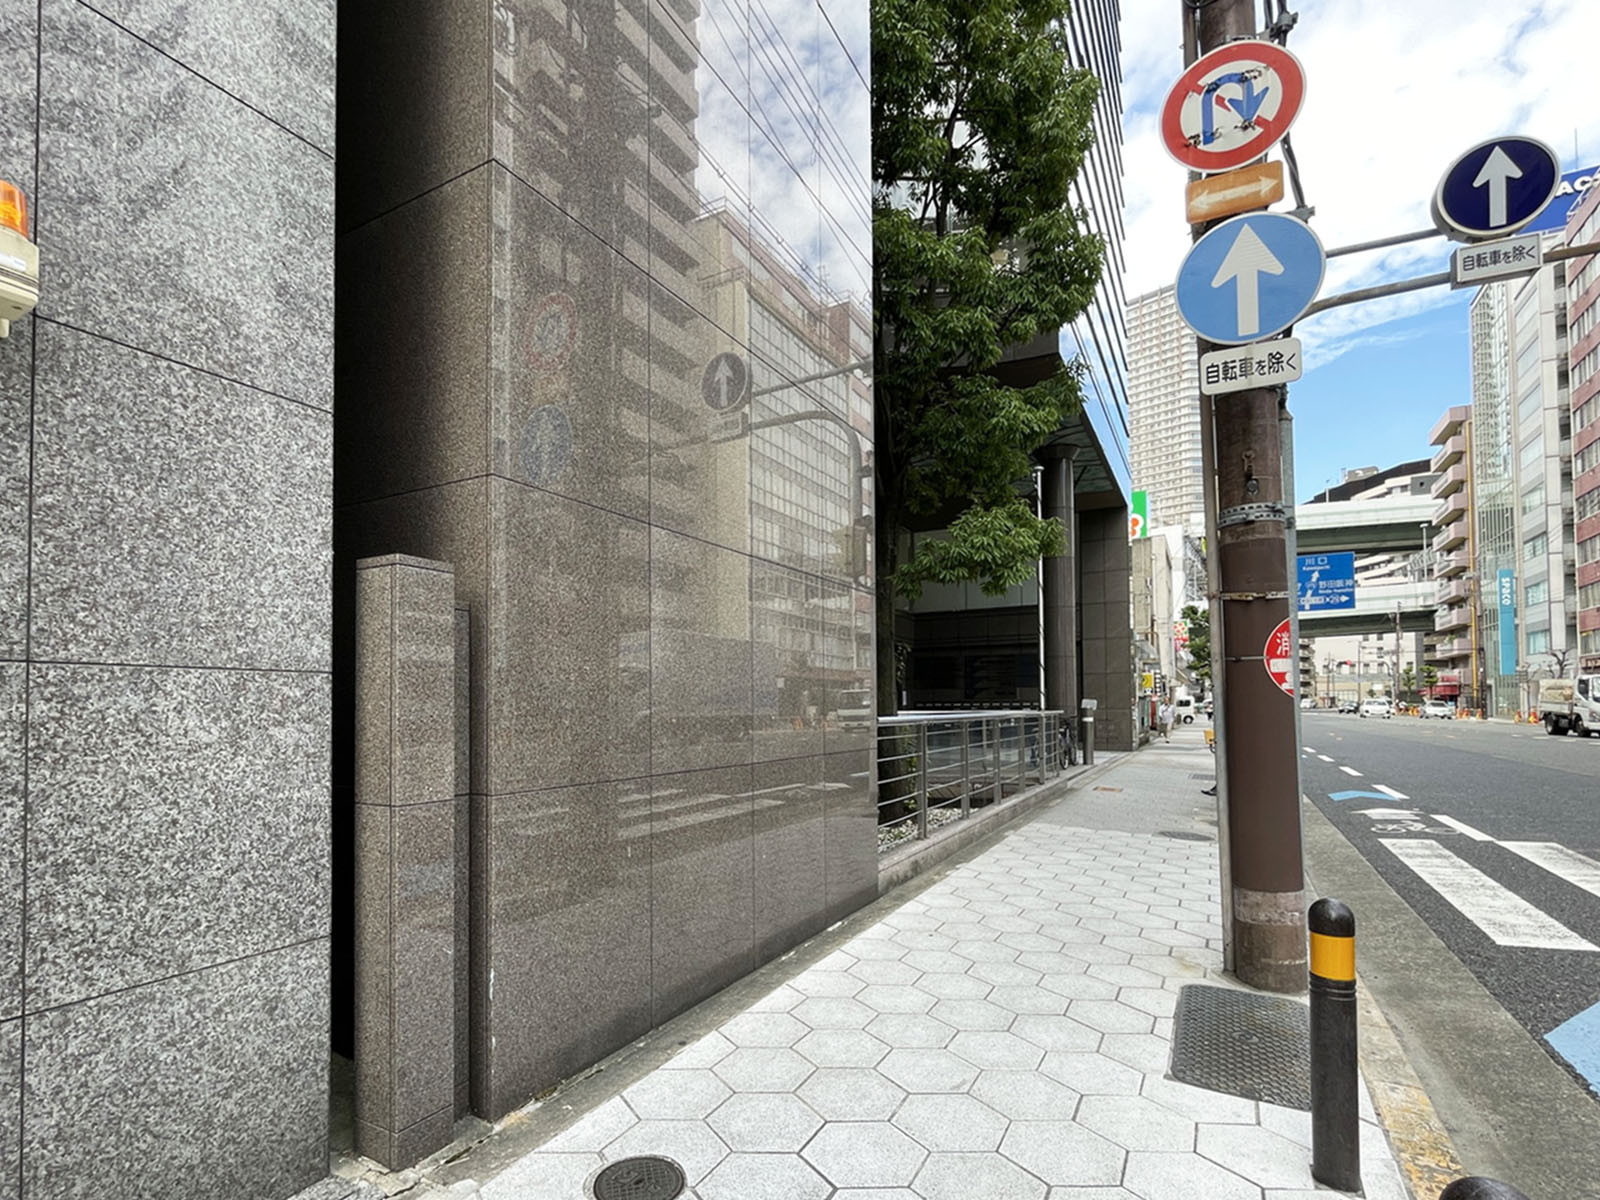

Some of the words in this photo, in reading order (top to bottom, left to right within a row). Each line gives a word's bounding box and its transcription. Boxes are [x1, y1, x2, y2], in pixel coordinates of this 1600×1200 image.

[1462, 244, 1536, 272] 自転車を除く
[1205, 350, 1298, 385] 自転車を除く
